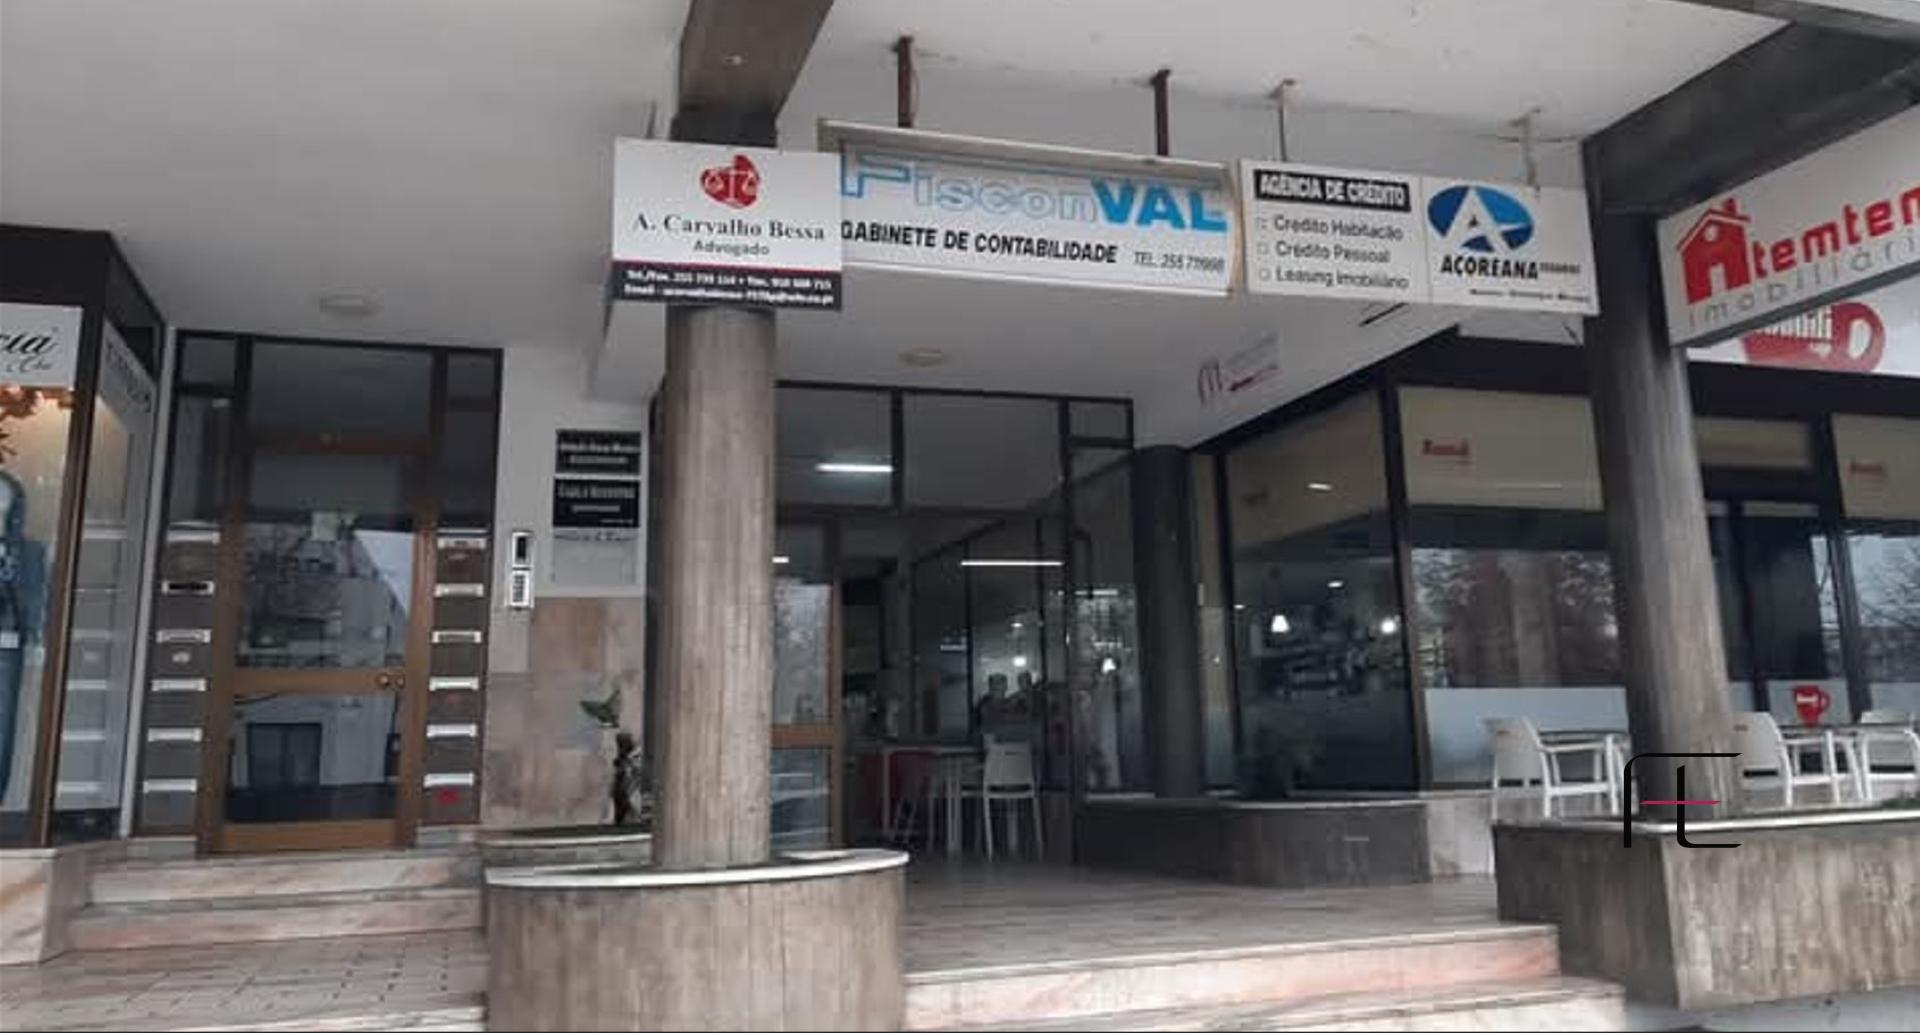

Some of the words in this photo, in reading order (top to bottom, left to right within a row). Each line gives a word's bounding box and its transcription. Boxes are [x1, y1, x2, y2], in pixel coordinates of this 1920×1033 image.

[1325, 178, 1346, 201] DE
[633, 212, 656, 231] A.
[663, 213, 762, 237] Carvalho
[769, 220, 824, 240] Bessa
[693, 240, 770, 257] Advogado
[841, 219, 938, 248] GABINETE
[944, 229, 970, 250] DE
[974, 231, 1118, 264] CONTABILIDADE
[1333, 243, 1391, 264] Pessoal
[1275, 266, 1334, 287] Leasing
